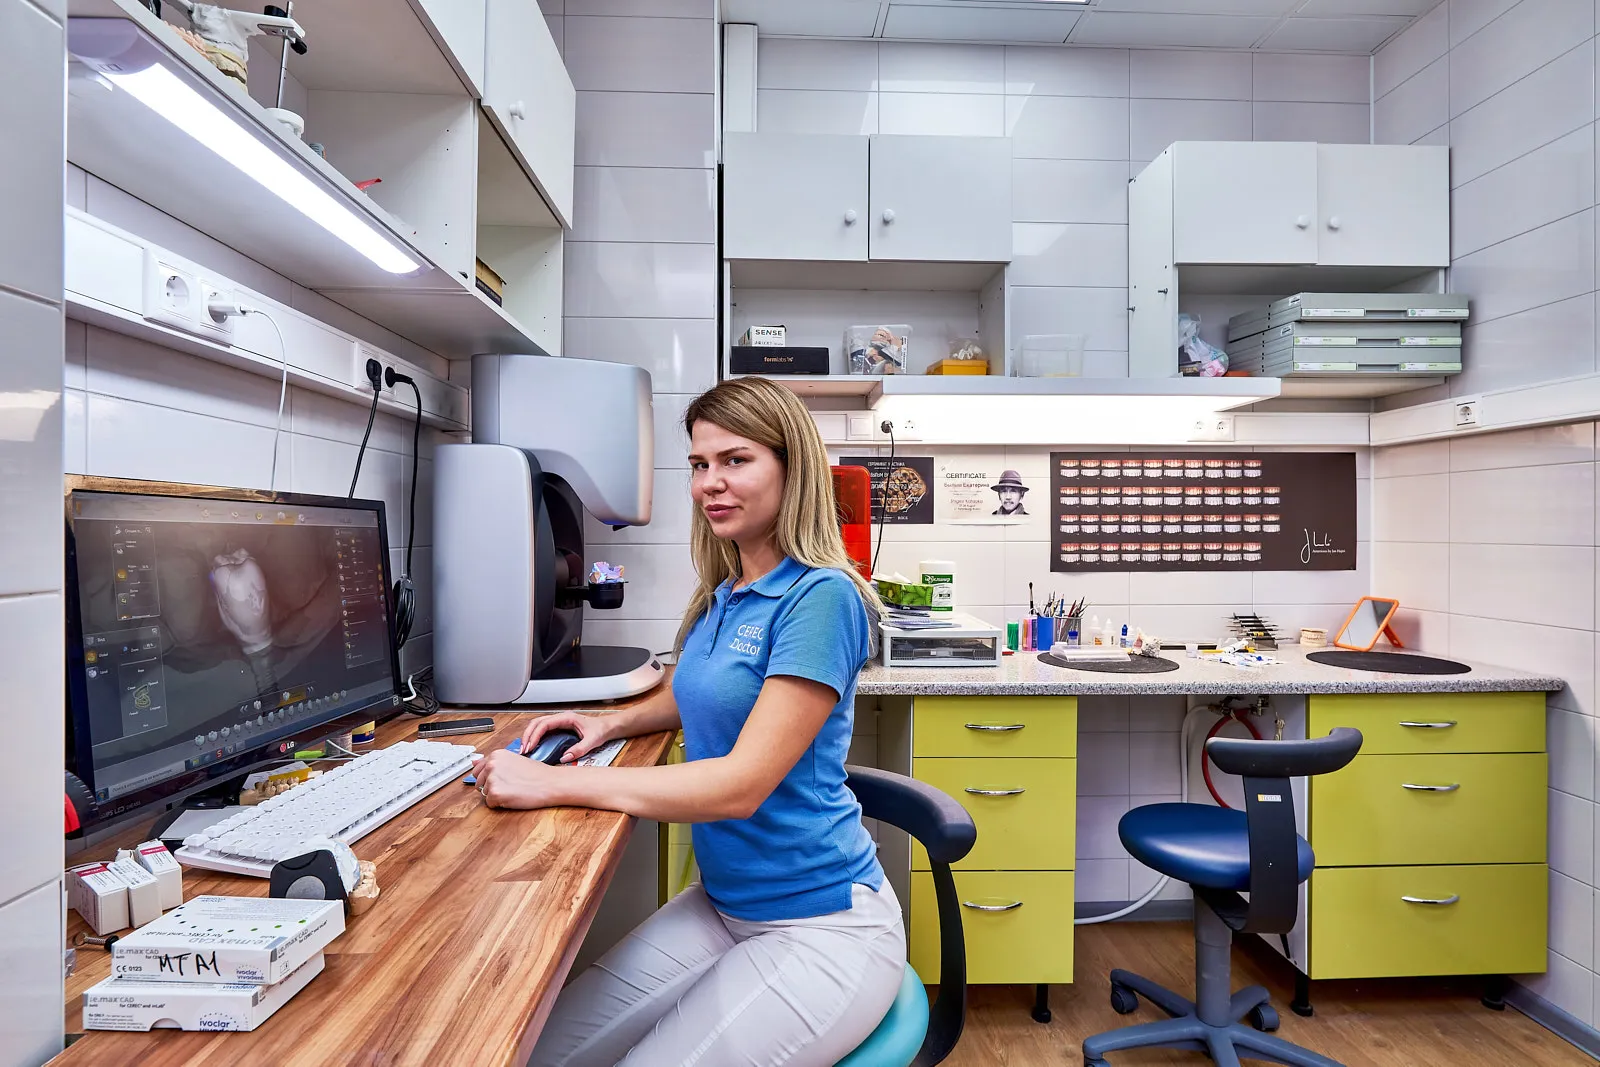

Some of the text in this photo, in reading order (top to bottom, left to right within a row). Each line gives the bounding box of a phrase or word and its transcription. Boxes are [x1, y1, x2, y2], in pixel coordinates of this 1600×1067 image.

[729, 638, 761, 655] Doctor
[286, 741, 295, 749] LG
[199, 1020, 230, 1028] ivoclar
